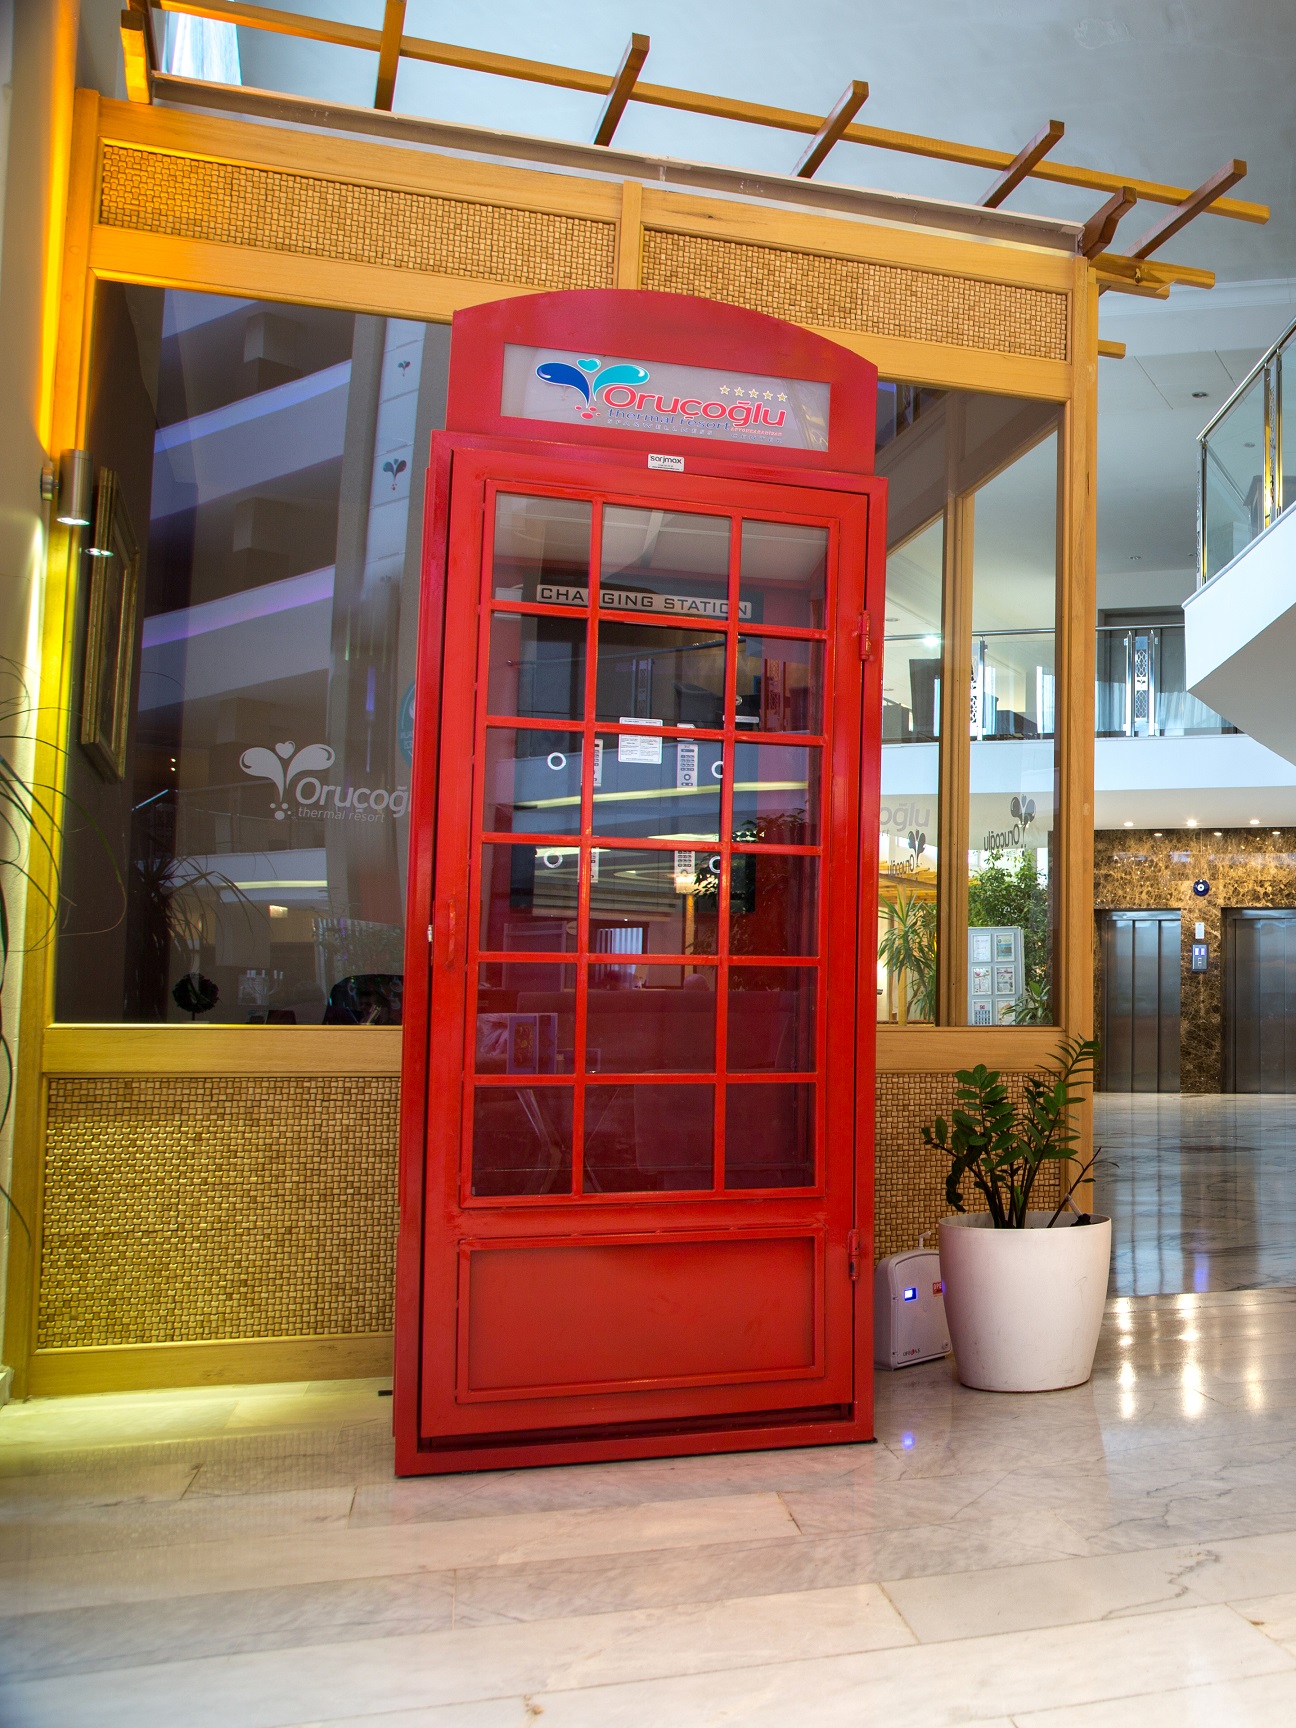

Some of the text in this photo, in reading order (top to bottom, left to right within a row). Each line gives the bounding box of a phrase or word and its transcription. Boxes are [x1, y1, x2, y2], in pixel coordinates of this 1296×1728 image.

[602, 384, 787, 427] Oruçoğlu
[608, 408, 731, 431] thermal resort
[541, 587, 748, 616] CHAGING STATION
[295, 777, 411, 818] Oruçoğ
[298, 807, 345, 820] thermal
[348, 812, 385, 823] resort
[879, 802, 931, 832] oğlu
